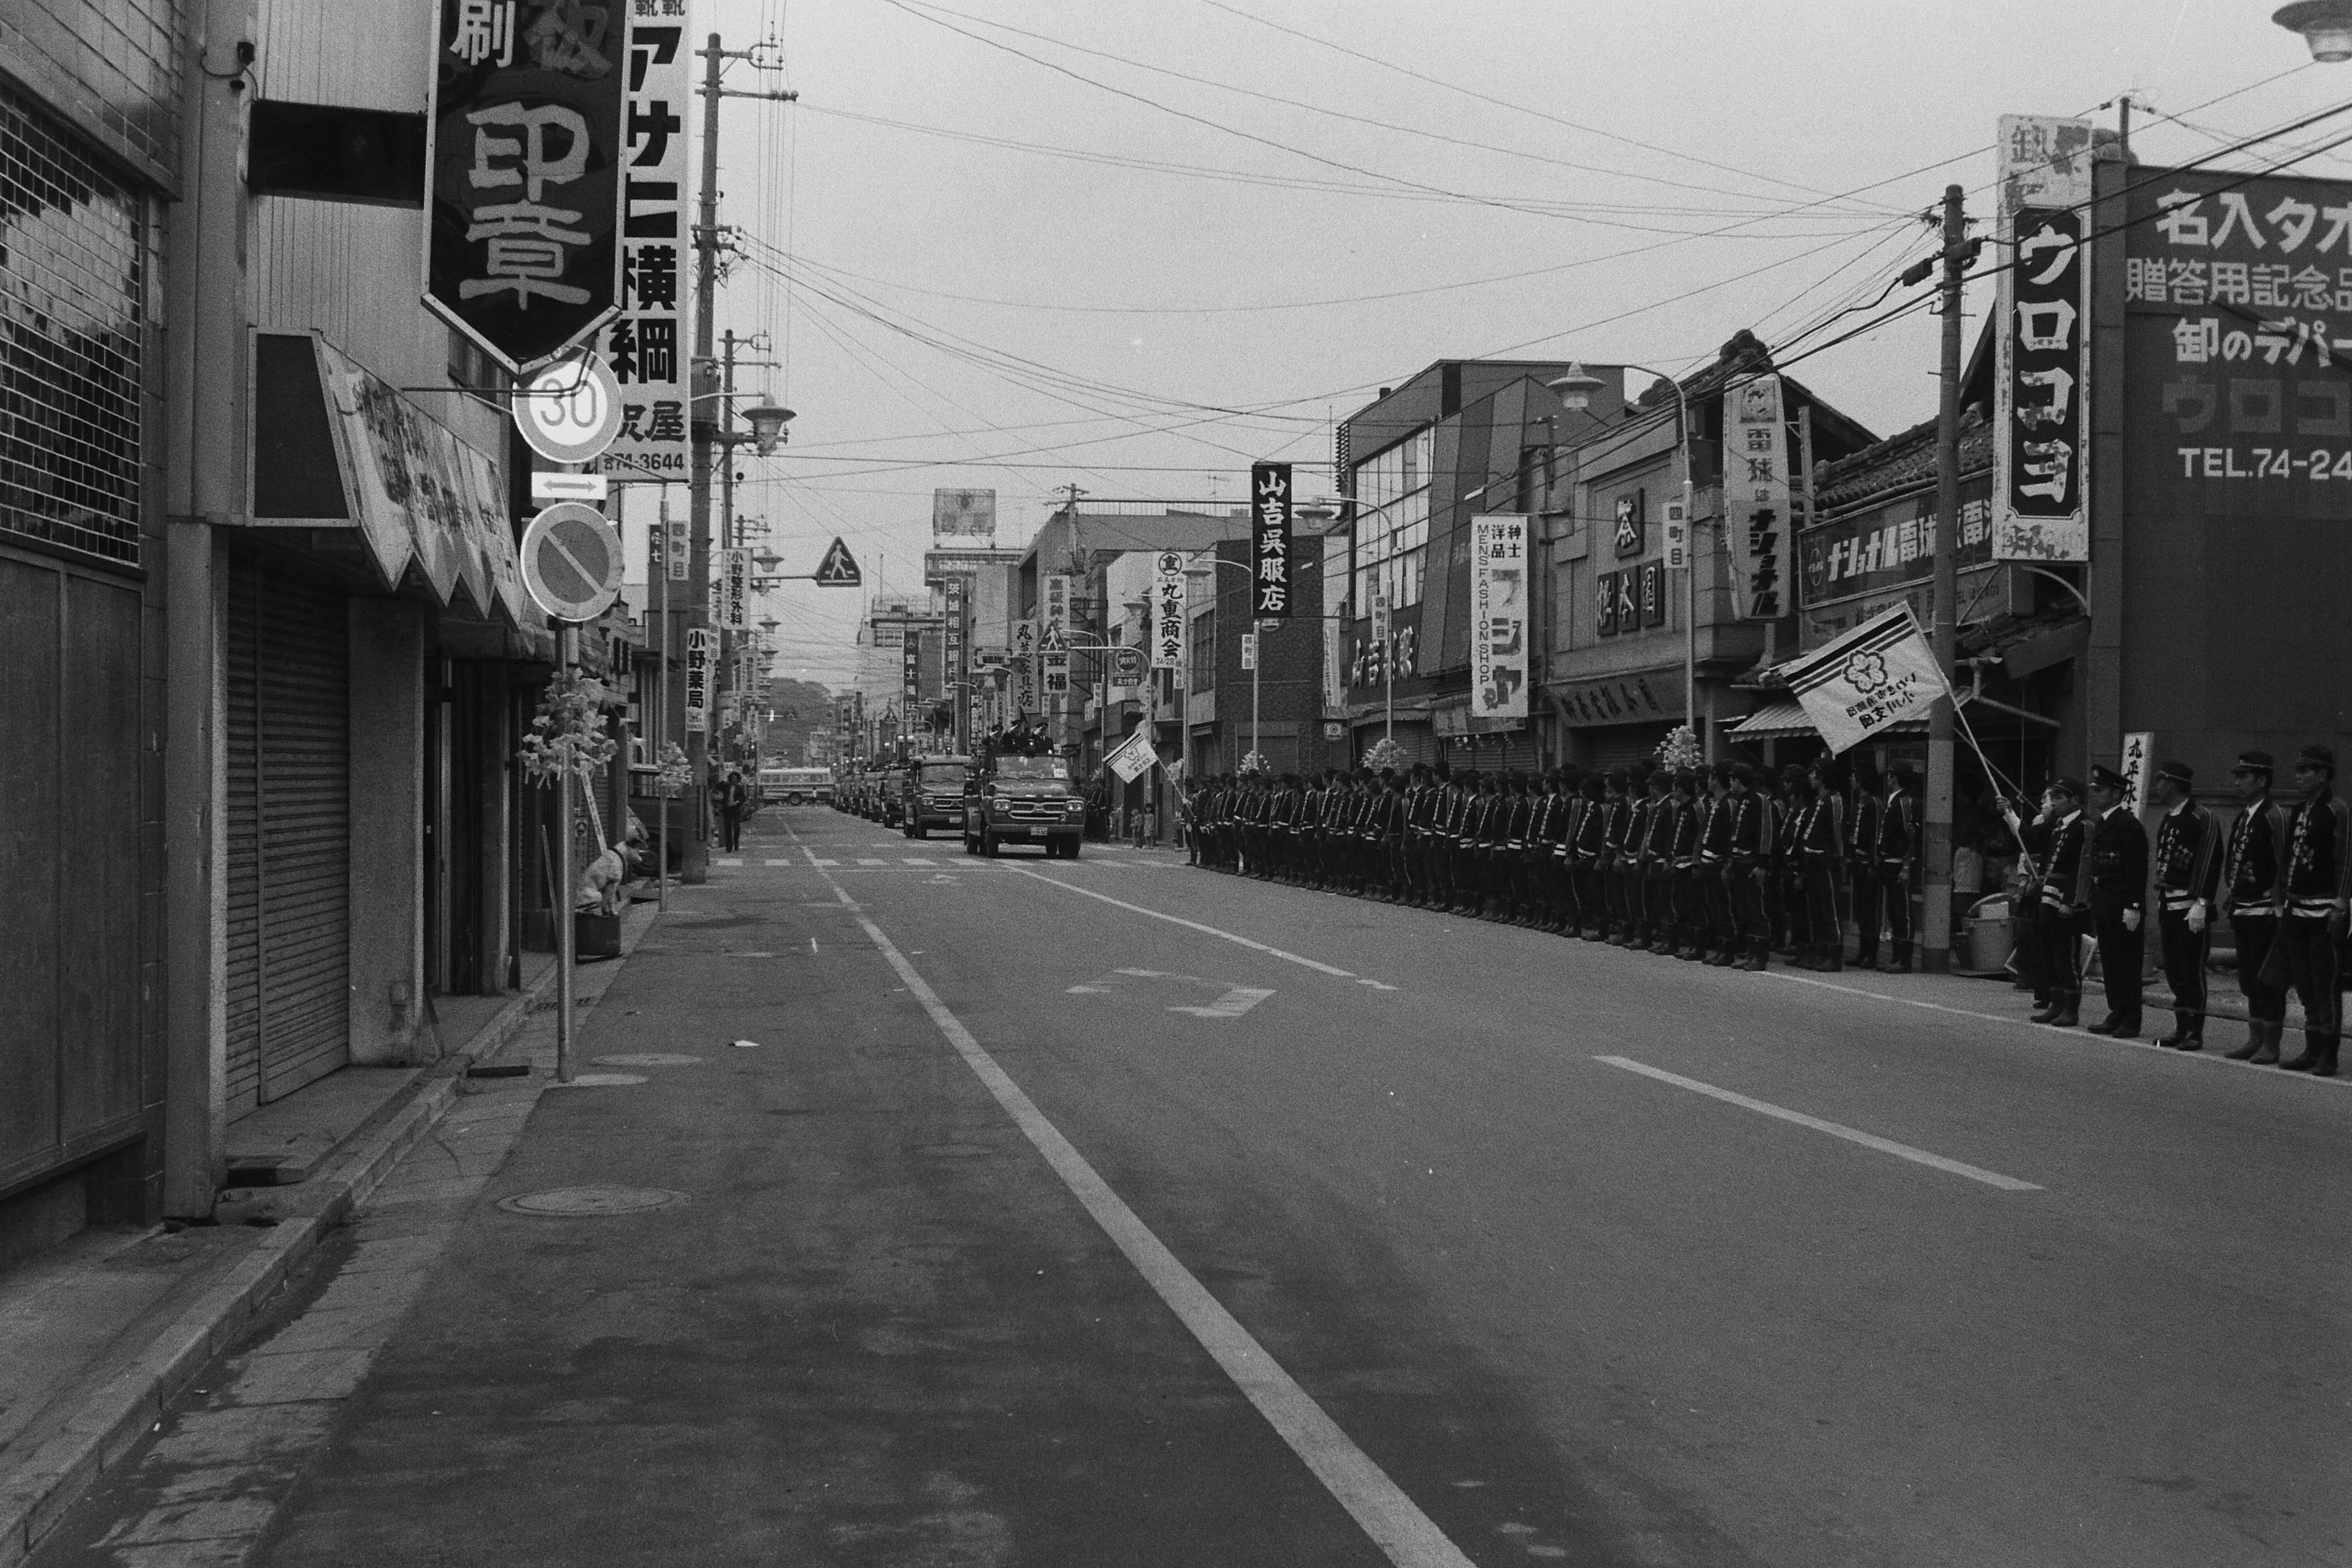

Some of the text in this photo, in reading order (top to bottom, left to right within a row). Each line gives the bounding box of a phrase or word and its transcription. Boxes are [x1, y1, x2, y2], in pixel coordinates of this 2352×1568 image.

[2017, 222, 2078, 504] ウロコヨ
[541, 377, 598, 429] 30
[1747, 429, 1773, 502] 電球は
[1258, 471, 1287, 611] 山吉呉服店
[1491, 525, 1506, 558] 洋品
[1508, 525, 1522, 558] 紳士
[1669, 506, 1684, 566] 四町目
[1749, 509, 1779, 616] ナショナル
[1160, 583, 1183, 658] 丸重商会
[1479, 569, 1489, 641] FASHION
[689, 630, 705, 709] 小野薬局
[1480, 645, 1489, 685] SHOP
